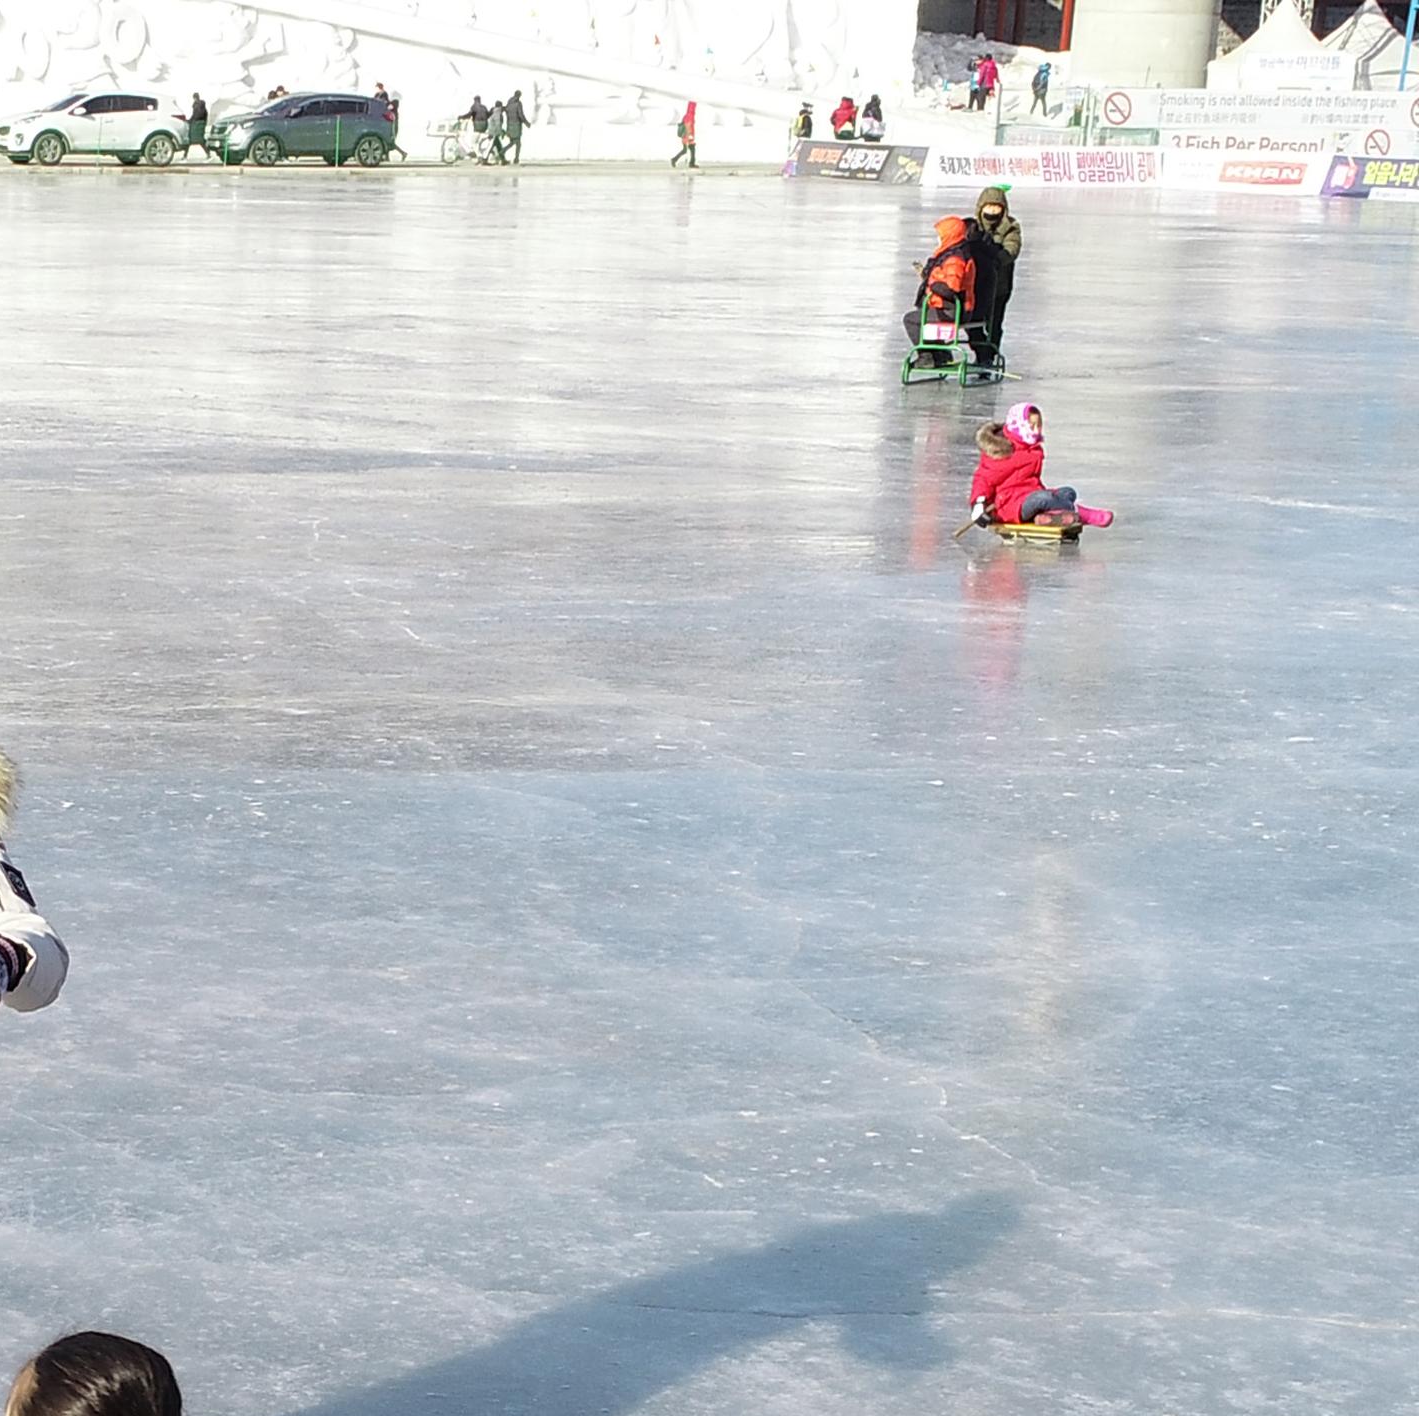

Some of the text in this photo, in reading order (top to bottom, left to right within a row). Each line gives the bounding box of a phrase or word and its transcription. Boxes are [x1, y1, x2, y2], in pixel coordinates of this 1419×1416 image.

[1159, 92, 1205, 109] Smoking
[1208, 95, 1217, 107] is
[1219, 96, 1237, 107] not
[1238, 95, 1281, 107] allowed
[1282, 95, 1313, 107] inside
[1315, 95, 1332, 108] the
[1334, 95, 1368, 110] fishing
[1224, 165, 1302, 181] KHAN
